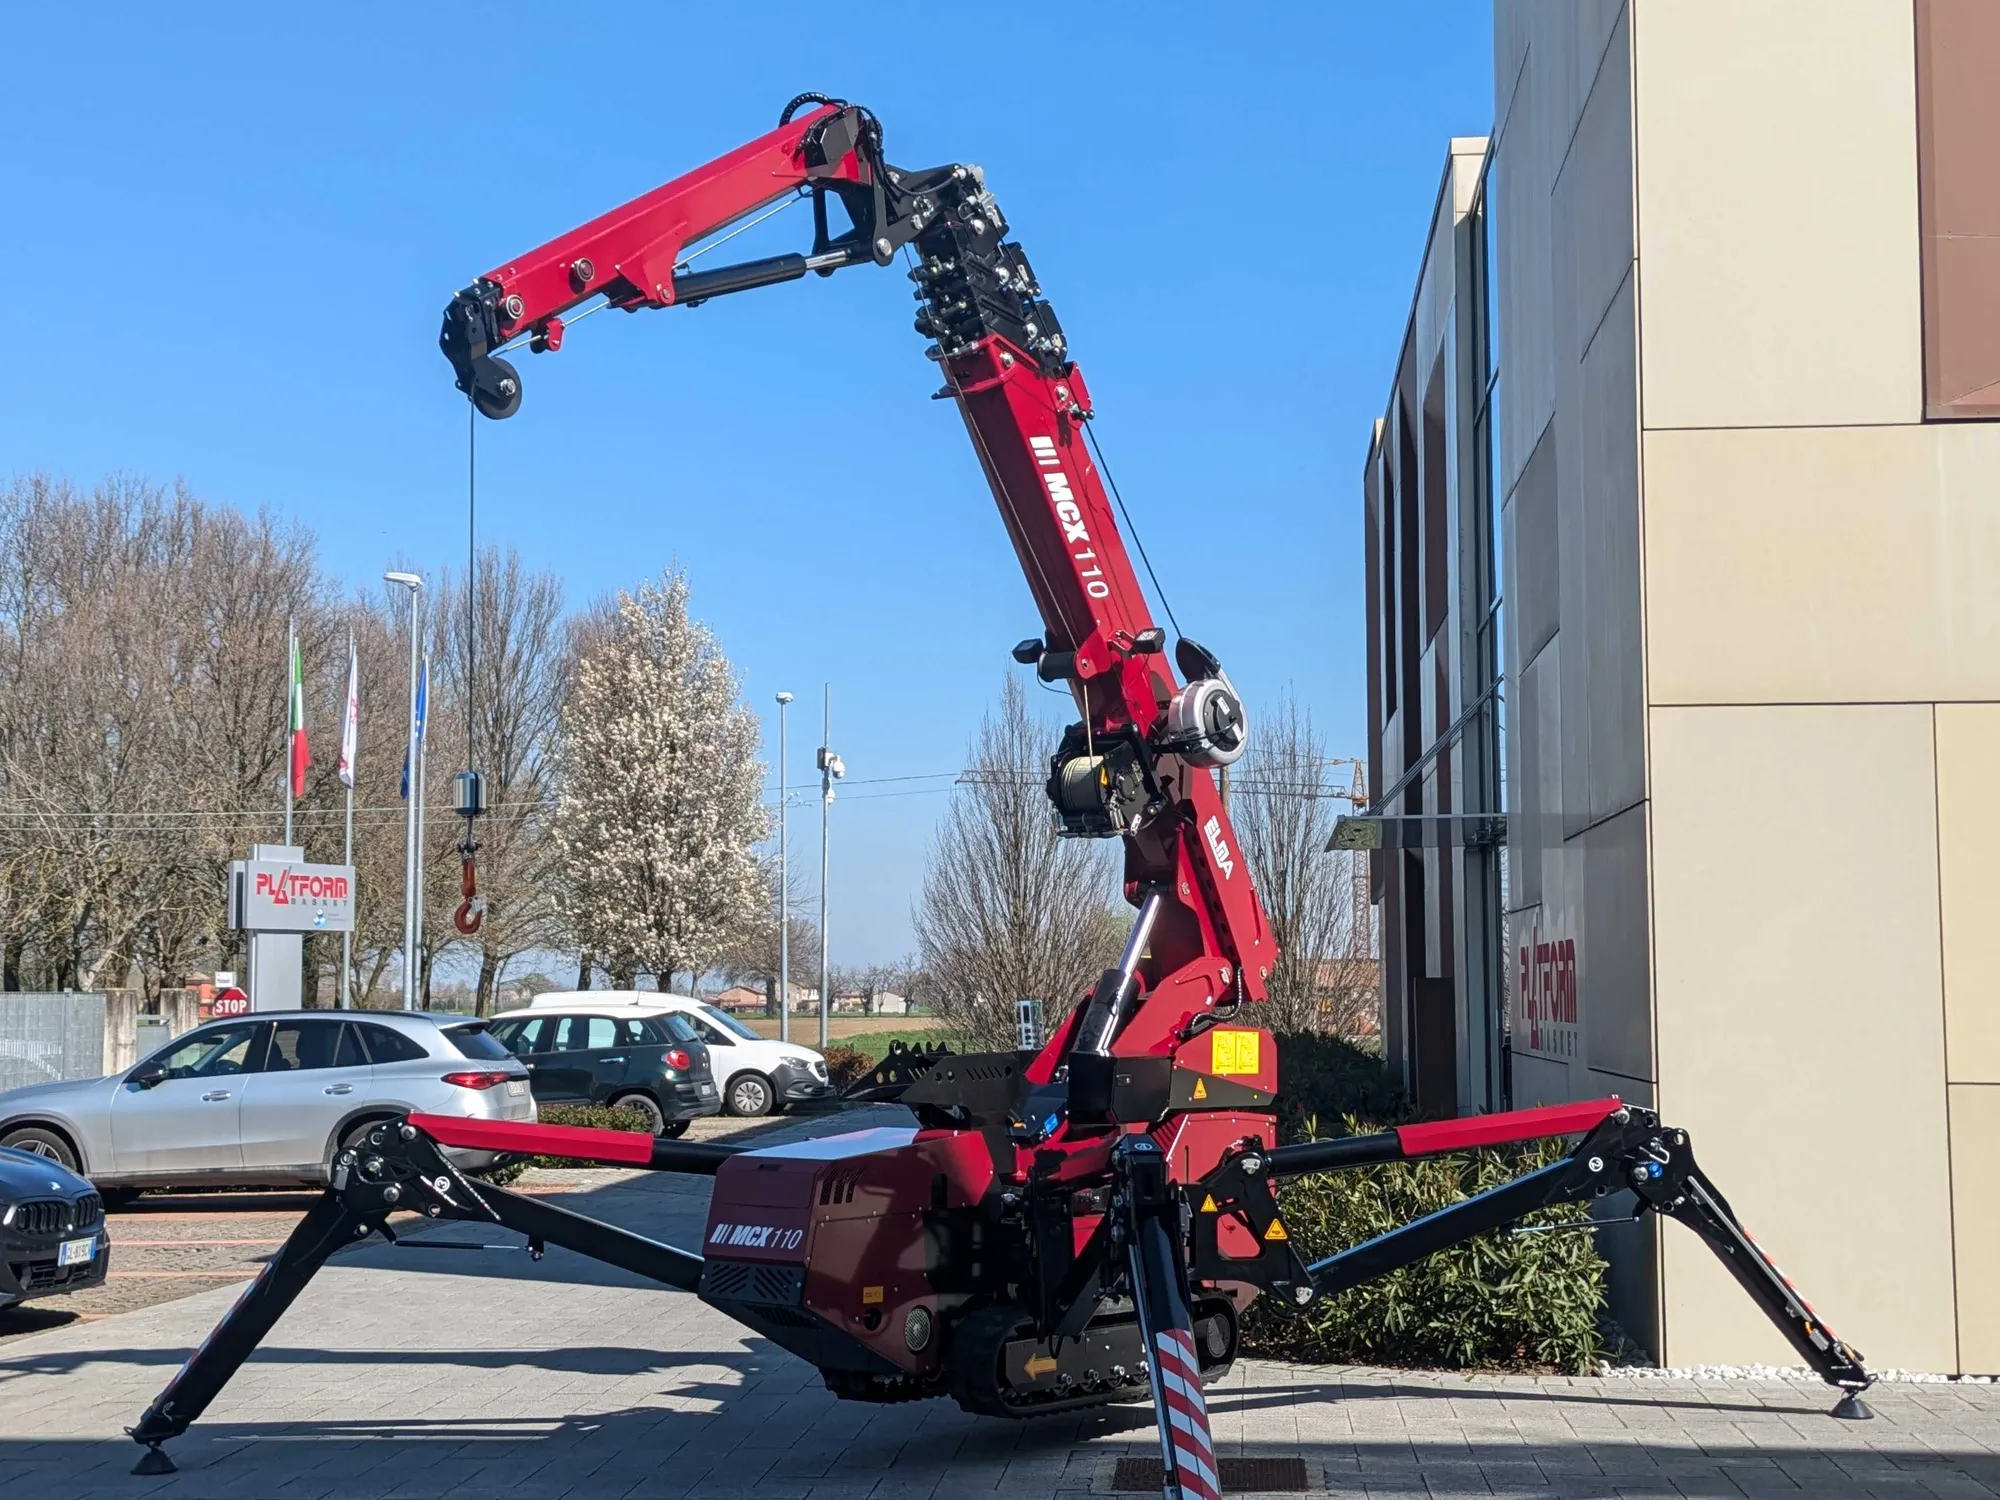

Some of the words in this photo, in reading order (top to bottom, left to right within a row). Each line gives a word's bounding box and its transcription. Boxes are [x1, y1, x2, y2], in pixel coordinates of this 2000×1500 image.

[1043, 472, 1090, 544] MCX
[1075, 547, 1109, 598] 110
[1204, 815, 1234, 880] ELMA
[256, 867, 348, 904] PLATFORM
[290, 897, 349, 907] BASKET
[1520, 915, 1577, 1050] PLATFORM
[215, 999, 247, 1014] STOP
[436, 1178, 449, 1190] 3
[728, 1225, 774, 1247] MCX
[771, 1228, 803, 1249] 110
